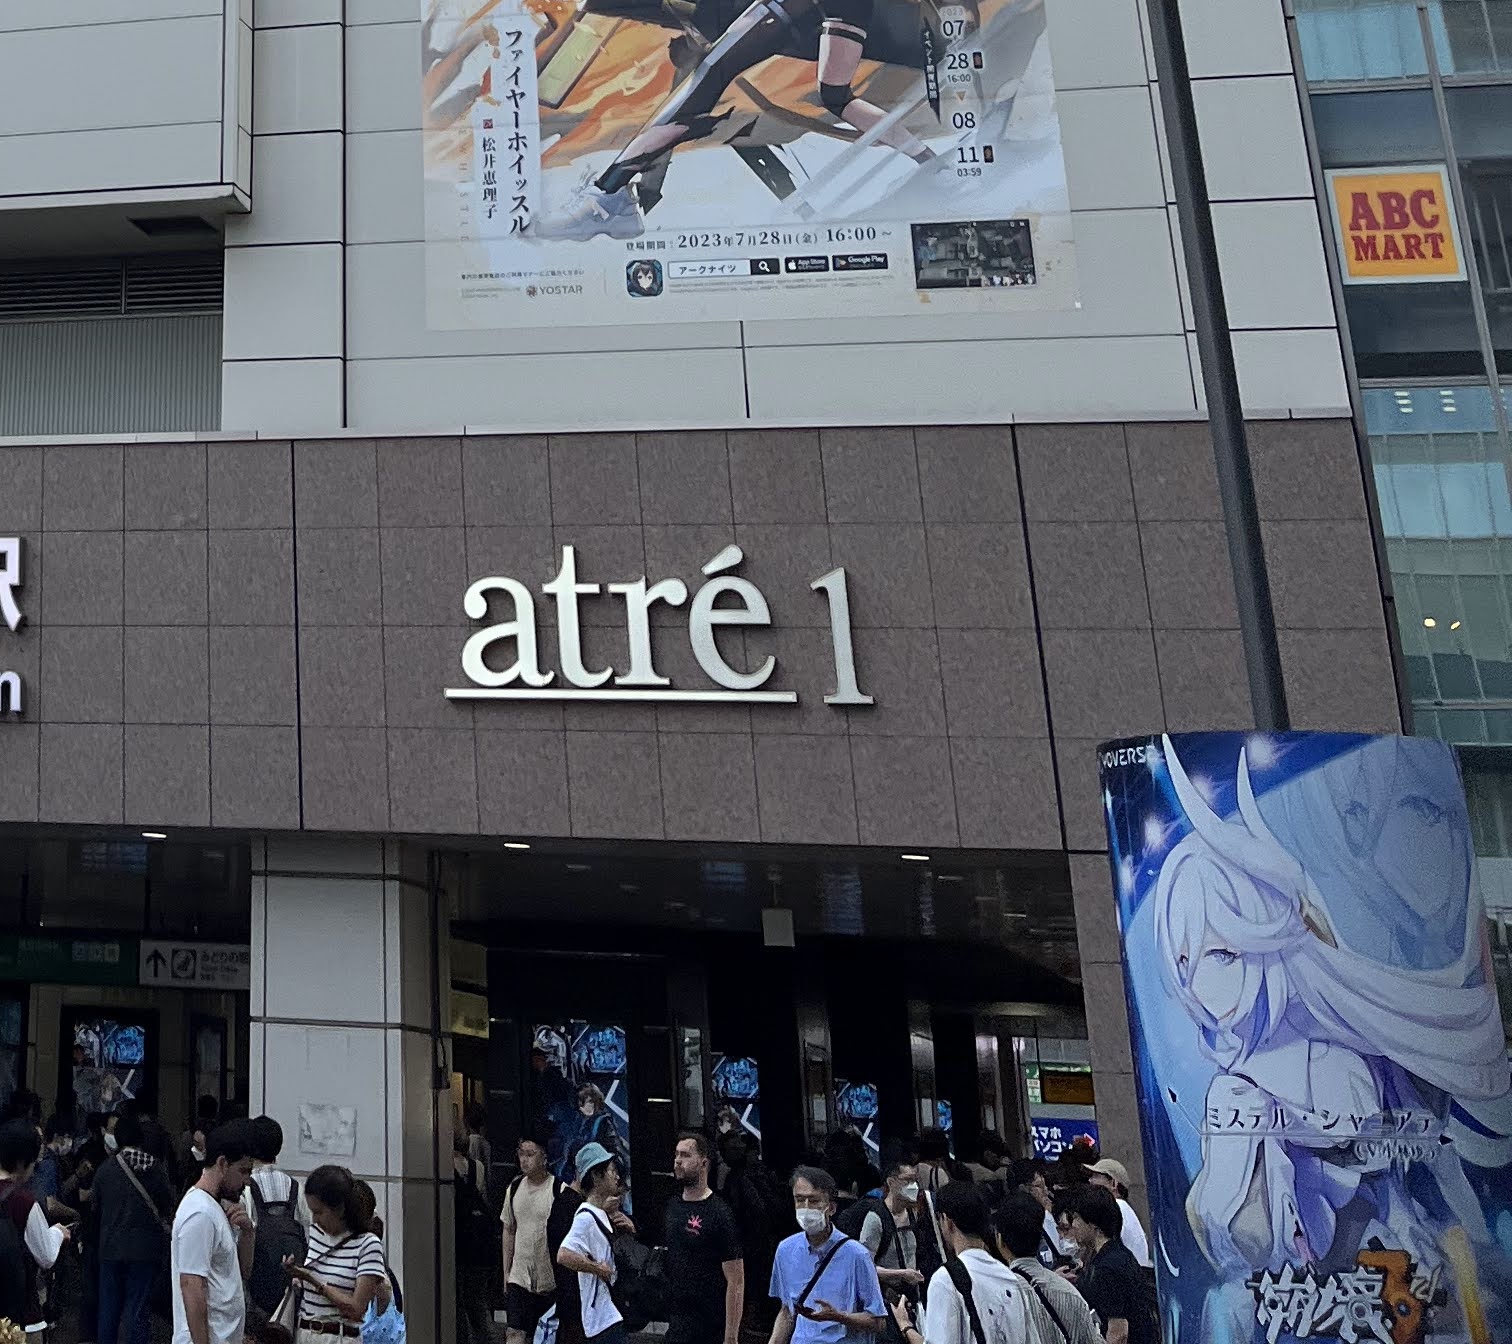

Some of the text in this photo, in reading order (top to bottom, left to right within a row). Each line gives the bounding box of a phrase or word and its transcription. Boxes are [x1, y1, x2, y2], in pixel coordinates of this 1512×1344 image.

[942, 20, 965, 37] 07
[946, 53, 970, 70] 28
[947, 73, 972, 83] 16:00
[952, 112, 976, 129] 08
[505, 29, 530, 236] ファイヤーホイッスル
[957, 146, 980, 164] 11
[482, 135, 498, 220] 松井恵理子
[957, 167, 982, 178] 03:59
[1348, 189, 1440, 232] ABC
[1351, 231, 1444, 263] MART
[678, 264, 737, 276] アークナイツ
[539, 284, 584, 296] YOSTAR
[460, 543, 875, 705] atré 1
[1207, 1106, 1435, 1133] ミステル・シャニアテ
